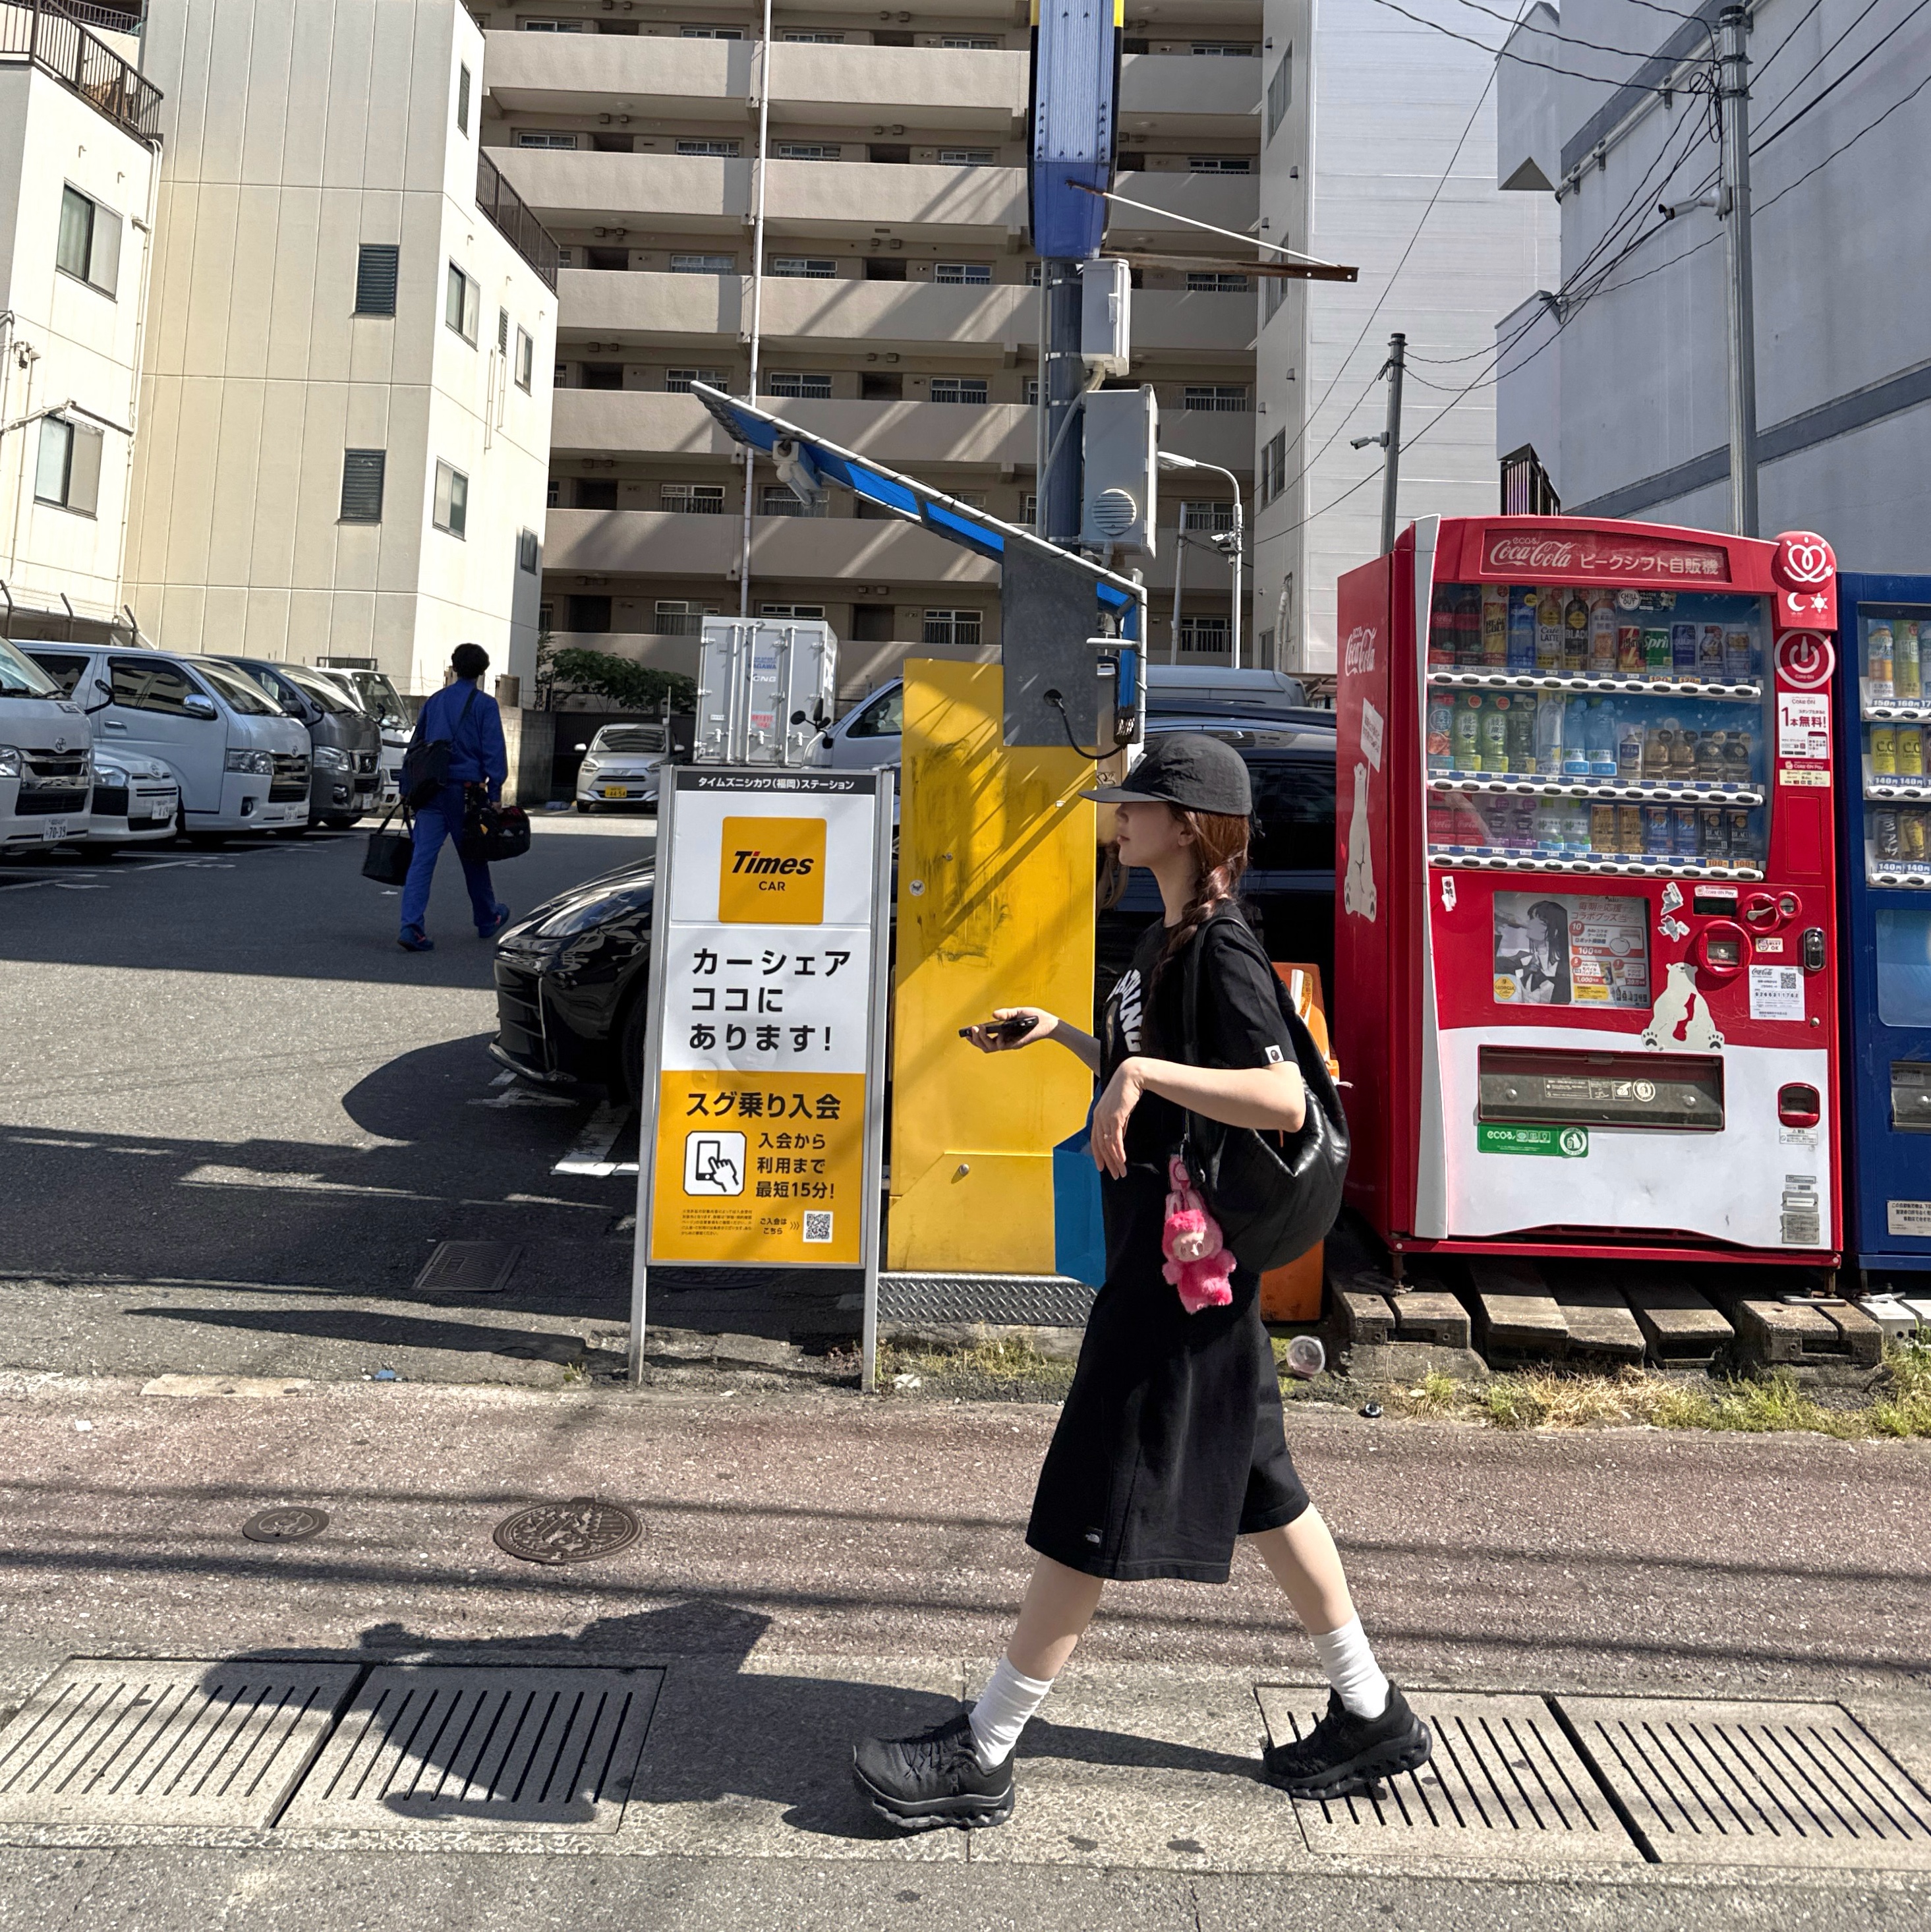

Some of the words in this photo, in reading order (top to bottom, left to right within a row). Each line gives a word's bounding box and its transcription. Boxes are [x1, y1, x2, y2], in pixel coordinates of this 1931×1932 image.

[1490, 540, 1576, 568] Coca-Cola
[1581, 554, 1718, 575] ピークシフト自販機
[1345, 628, 1377, 676] Coca-Cola
[1781, 707, 1826, 728] 1本無料!
[698, 776, 855, 790] タイムズニシカワ(福岡)ステーション
[732, 851, 815, 875] Times
[759, 881, 786, 891] CAR
[692, 948, 851, 976] カーシェア
[691, 987, 783, 1012] ココに
[689, 1023, 832, 1052] あります!
[686, 1092, 841, 1120] スグ乗り入会
[757, 1132, 825, 1150] 入会から
[757, 1156, 825, 1174] 利用まで
[756, 1182, 834, 1199] 最短15分!
